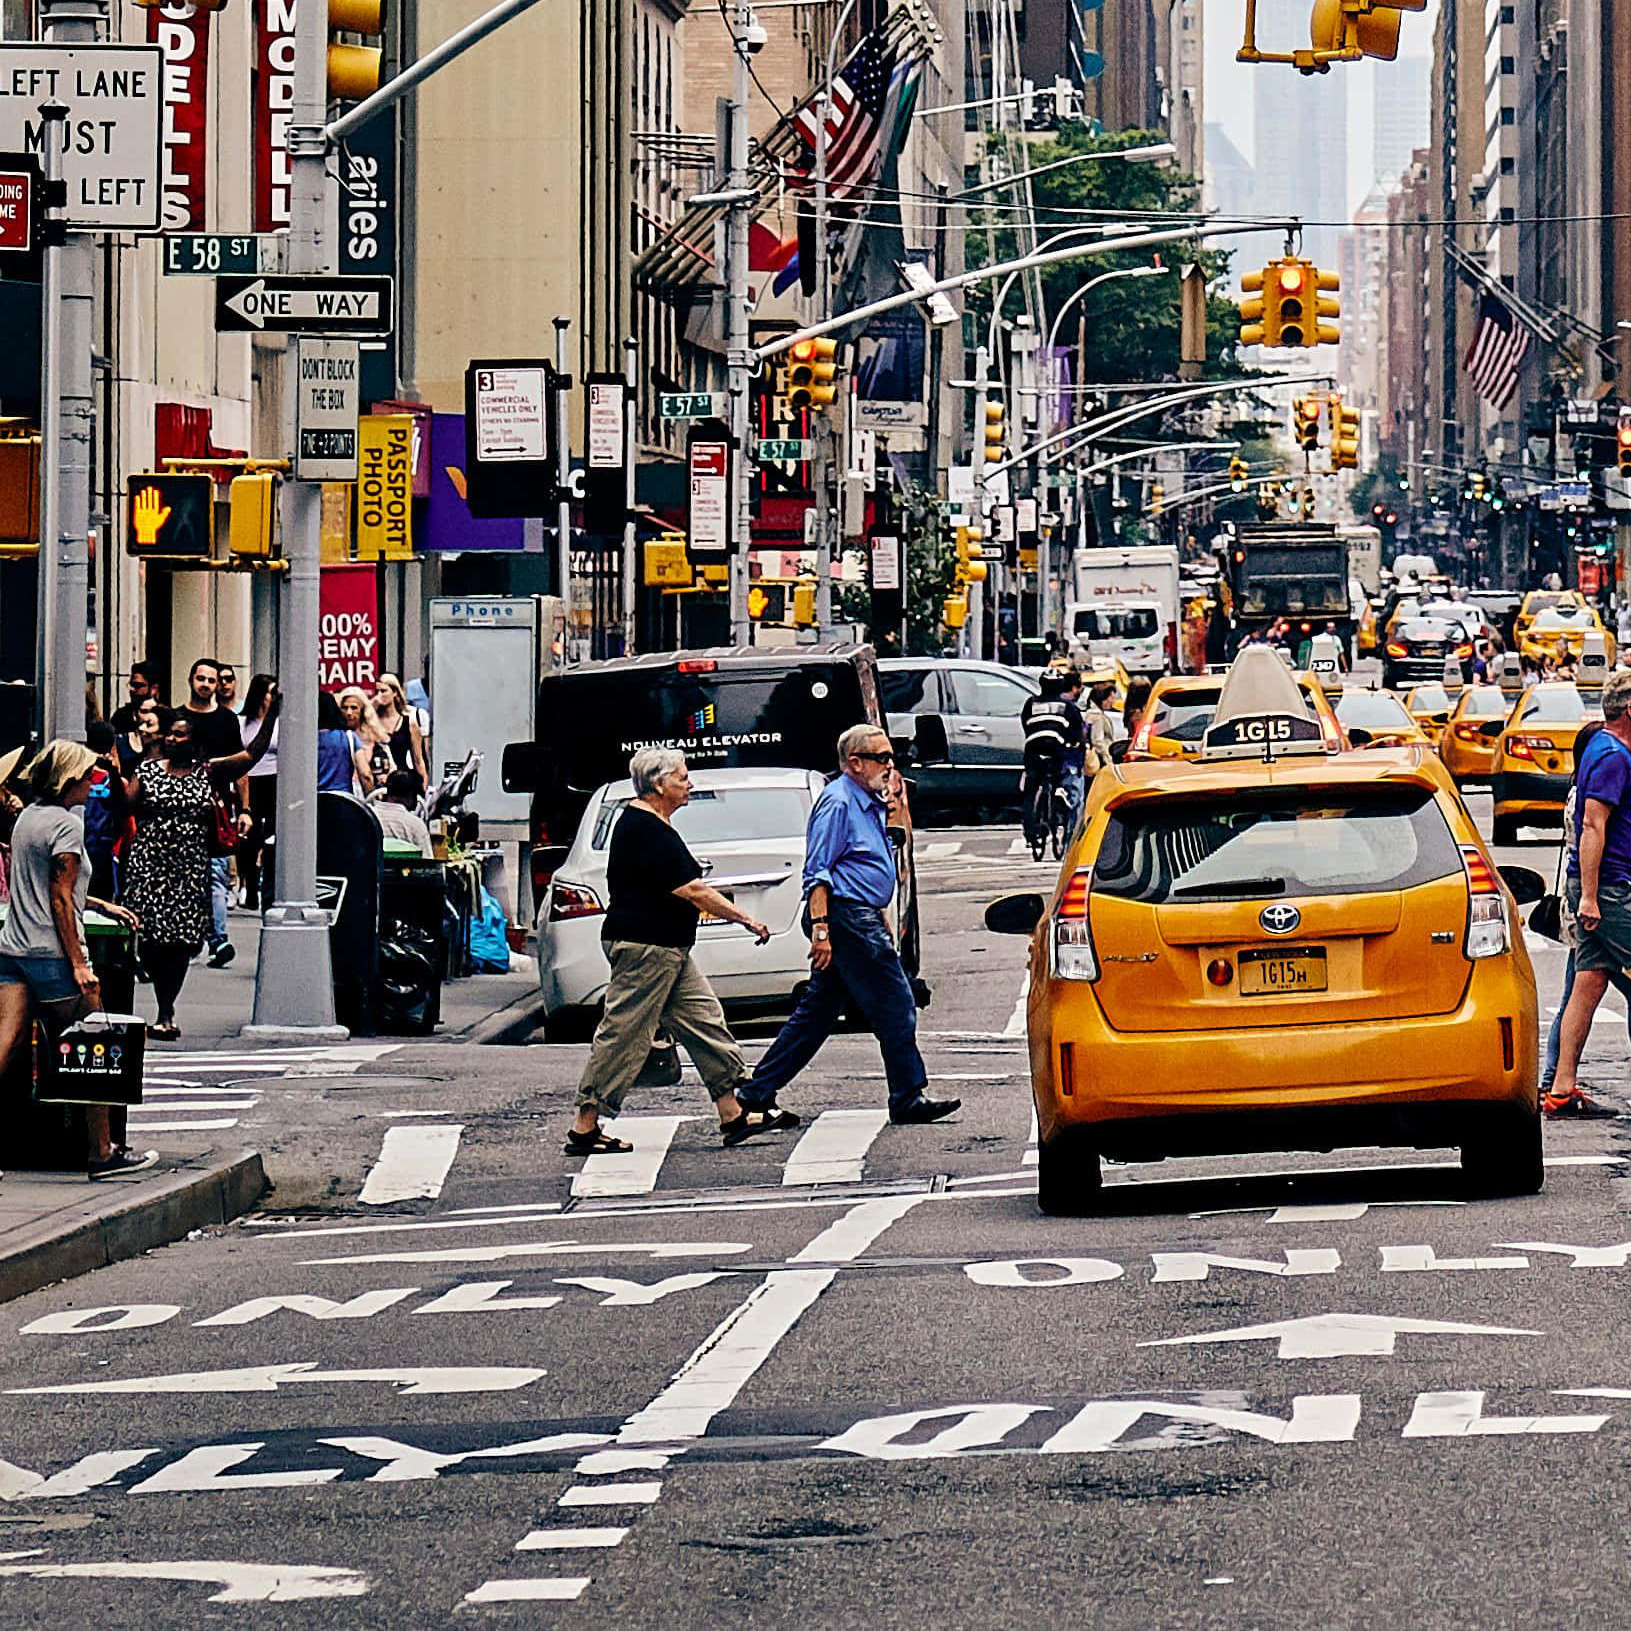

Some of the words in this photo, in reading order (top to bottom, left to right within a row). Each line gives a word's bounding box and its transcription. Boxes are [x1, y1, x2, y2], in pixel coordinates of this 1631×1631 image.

[76, 70, 146, 98] LANE
[81, 178, 146, 206] LEFT
[169, 239, 182, 270] E
[191, 238, 222, 271] 58
[230, 238, 251, 256] ST
[243, 293, 292, 315] ONE
[316, 293, 369, 315] WAY
[480, 372, 492, 390] 3
[662, 397, 670, 416] E
[676, 396, 693, 417] 57
[771, 441, 786, 459] 57
[363, 448, 384, 527] PHOTO
[387, 429, 407, 546] PASSPORT
[451, 604, 514, 617] Phone
[319, 613, 373, 637] 00%
[319, 637, 377, 660] EMY
[702, 732, 783, 747] ELEVATOR
[1235, 720, 1291, 743] 1G15
[19, 1271, 740, 1336] ONLY
